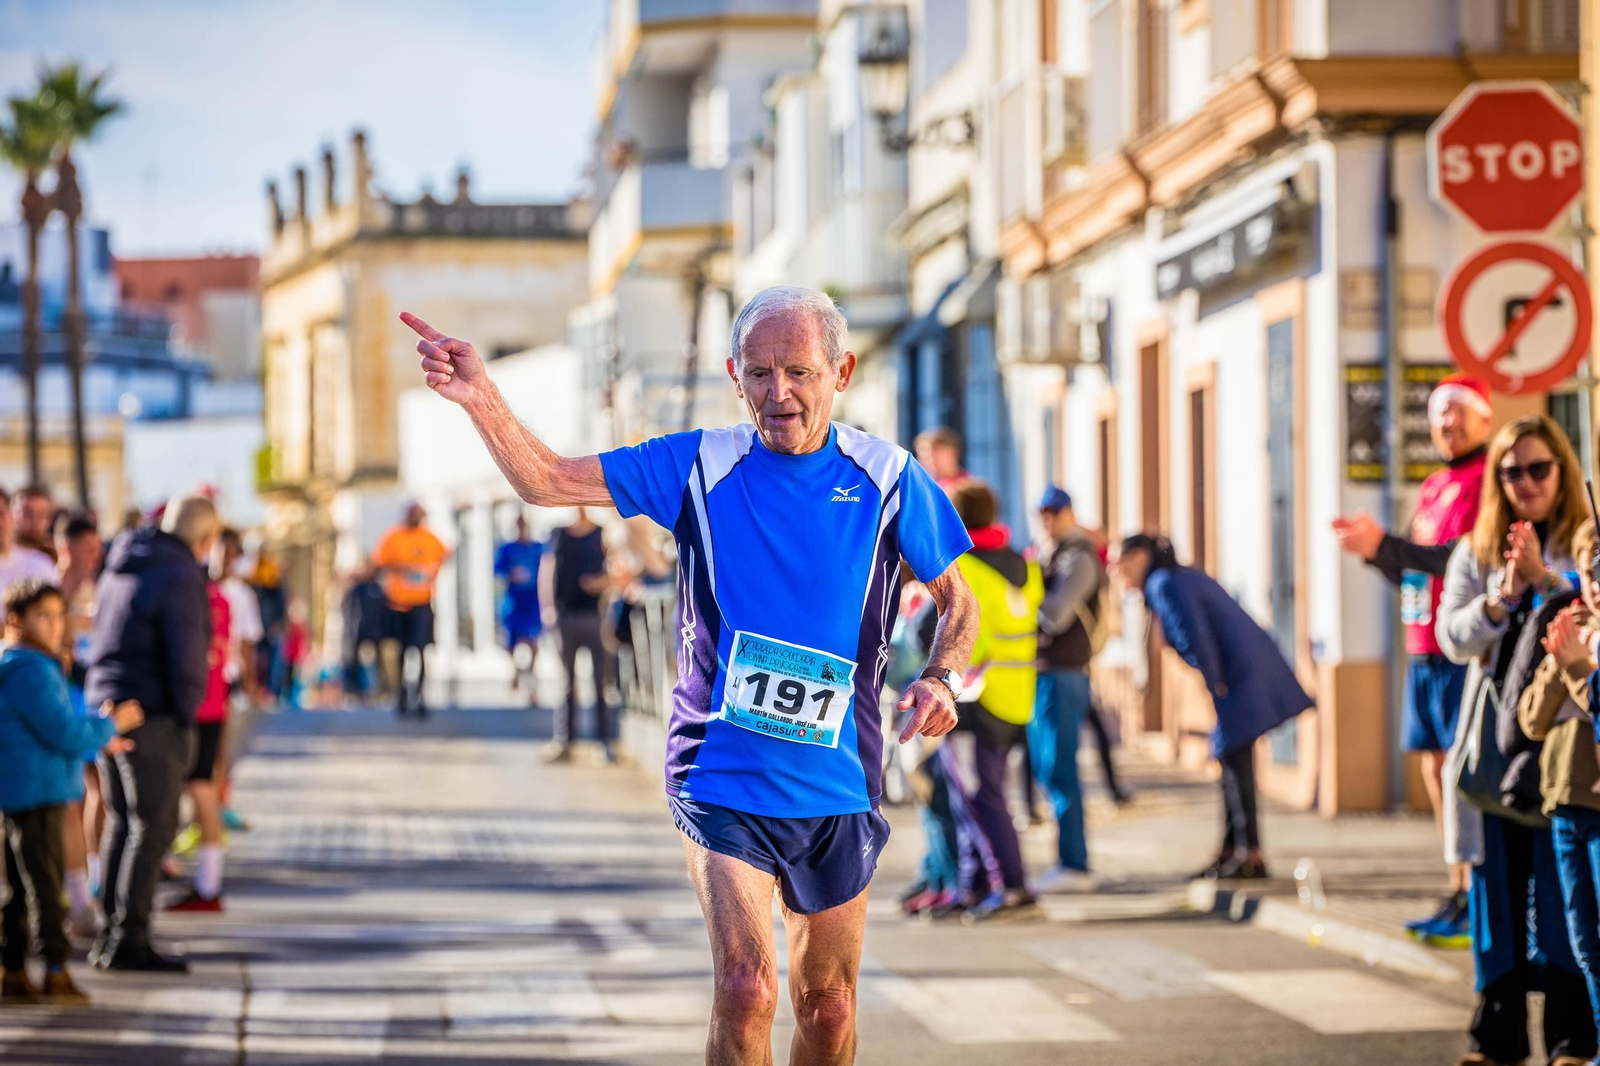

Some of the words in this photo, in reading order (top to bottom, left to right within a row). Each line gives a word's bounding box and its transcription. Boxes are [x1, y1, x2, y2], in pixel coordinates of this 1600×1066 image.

[1442, 140, 1581, 184] STOP
[831, 495, 860, 503] MIZUNO
[737, 638, 750, 658] X
[749, 640, 778, 656] CARRERA
[779, 647, 817, 666] SOLIDARIA
[746, 651, 768, 664] DIVINA
[769, 657, 799, 673] PASTORA
[745, 671, 836, 721] 191
[748, 707, 768, 718] MARTÍN
[768, 713, 793, 726] GALLARDO,
[794, 719, 807, 728] JOSÉ
[806, 722, 818, 730] LUIS
[756, 720, 797, 737] cajasur
